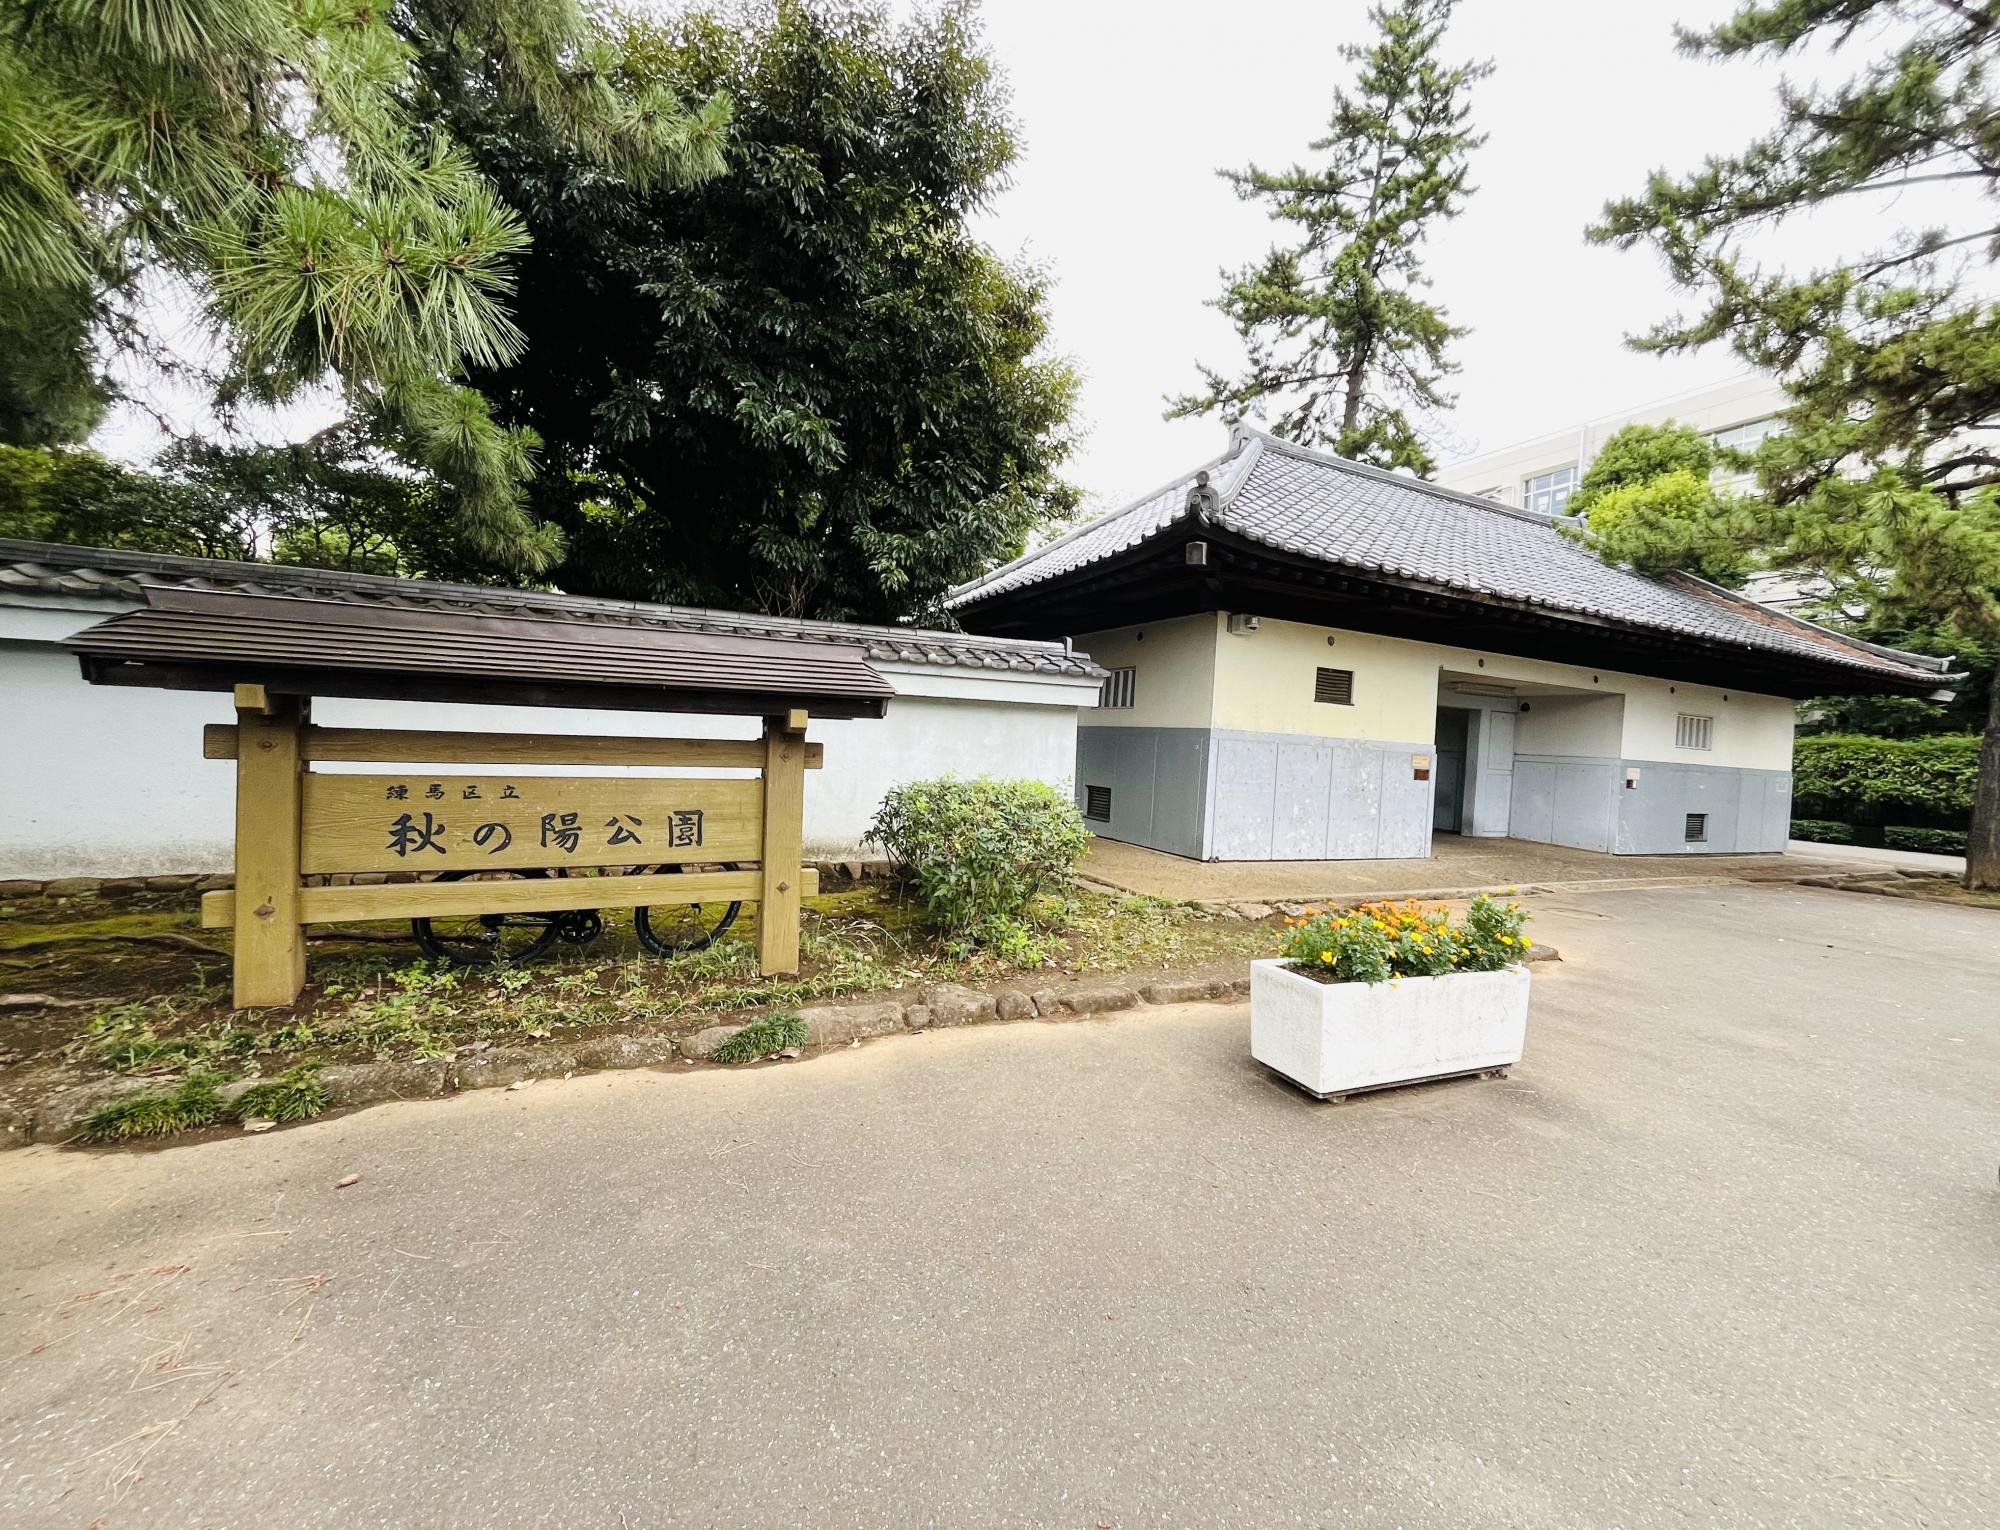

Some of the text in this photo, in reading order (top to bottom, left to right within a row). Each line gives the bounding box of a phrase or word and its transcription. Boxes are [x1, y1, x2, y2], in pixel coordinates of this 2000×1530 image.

[386, 784, 520, 800] 練馬区立
[386, 809, 704, 857] 秋の陽公園
